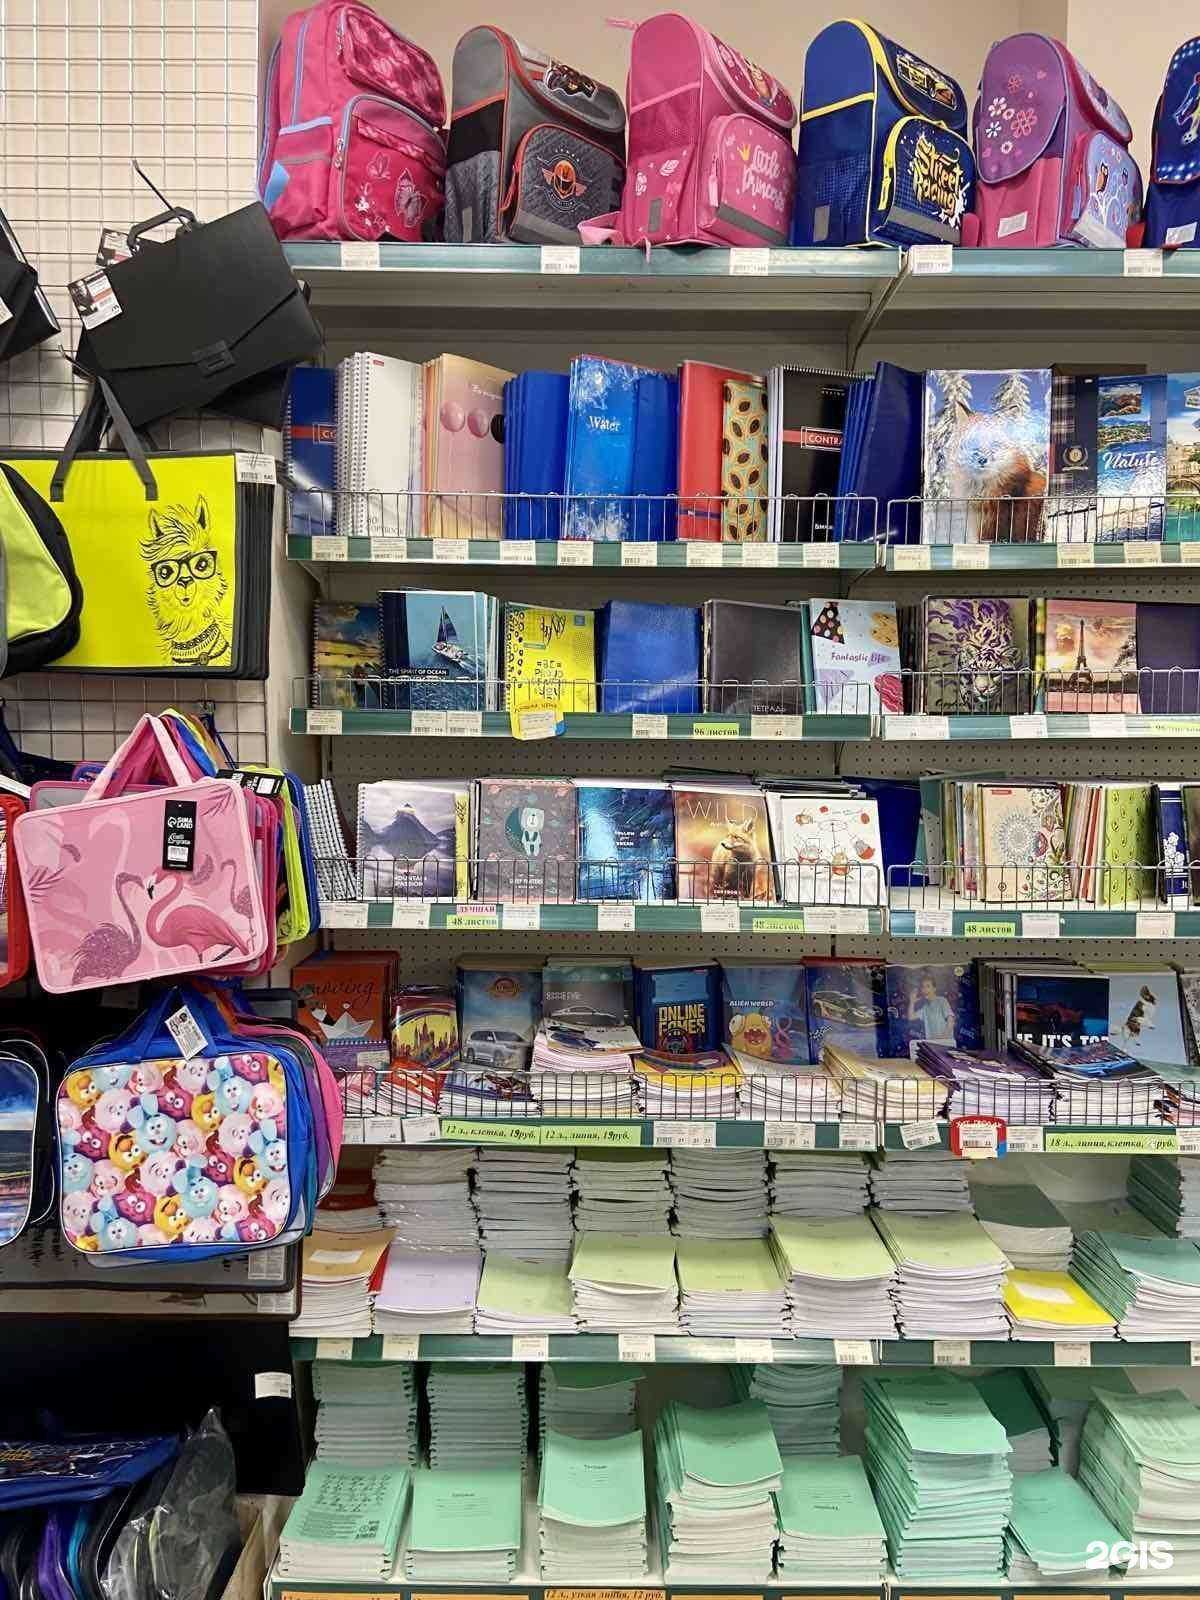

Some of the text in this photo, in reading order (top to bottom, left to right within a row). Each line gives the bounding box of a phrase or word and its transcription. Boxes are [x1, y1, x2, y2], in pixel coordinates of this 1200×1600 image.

[917, 136, 963, 198] Street
[1102, 451, 1160, 470] Nature
[831, 651, 868, 661] Fantastic
[694, 728, 738, 736] 96 листов
[686, 800, 759, 824] WILD
[453, 917, 463, 927] 48
[754, 919, 764, 929] 48
[966, 925, 1012, 934] 48 листов
[658, 1003, 705, 1021] ONLINE
[1042, 1034, 1072, 1048] IT'S
[446, 1125, 456, 1134] 12
[545, 1130, 555, 1139] 12
[1050, 1138, 1061, 1147] 18
